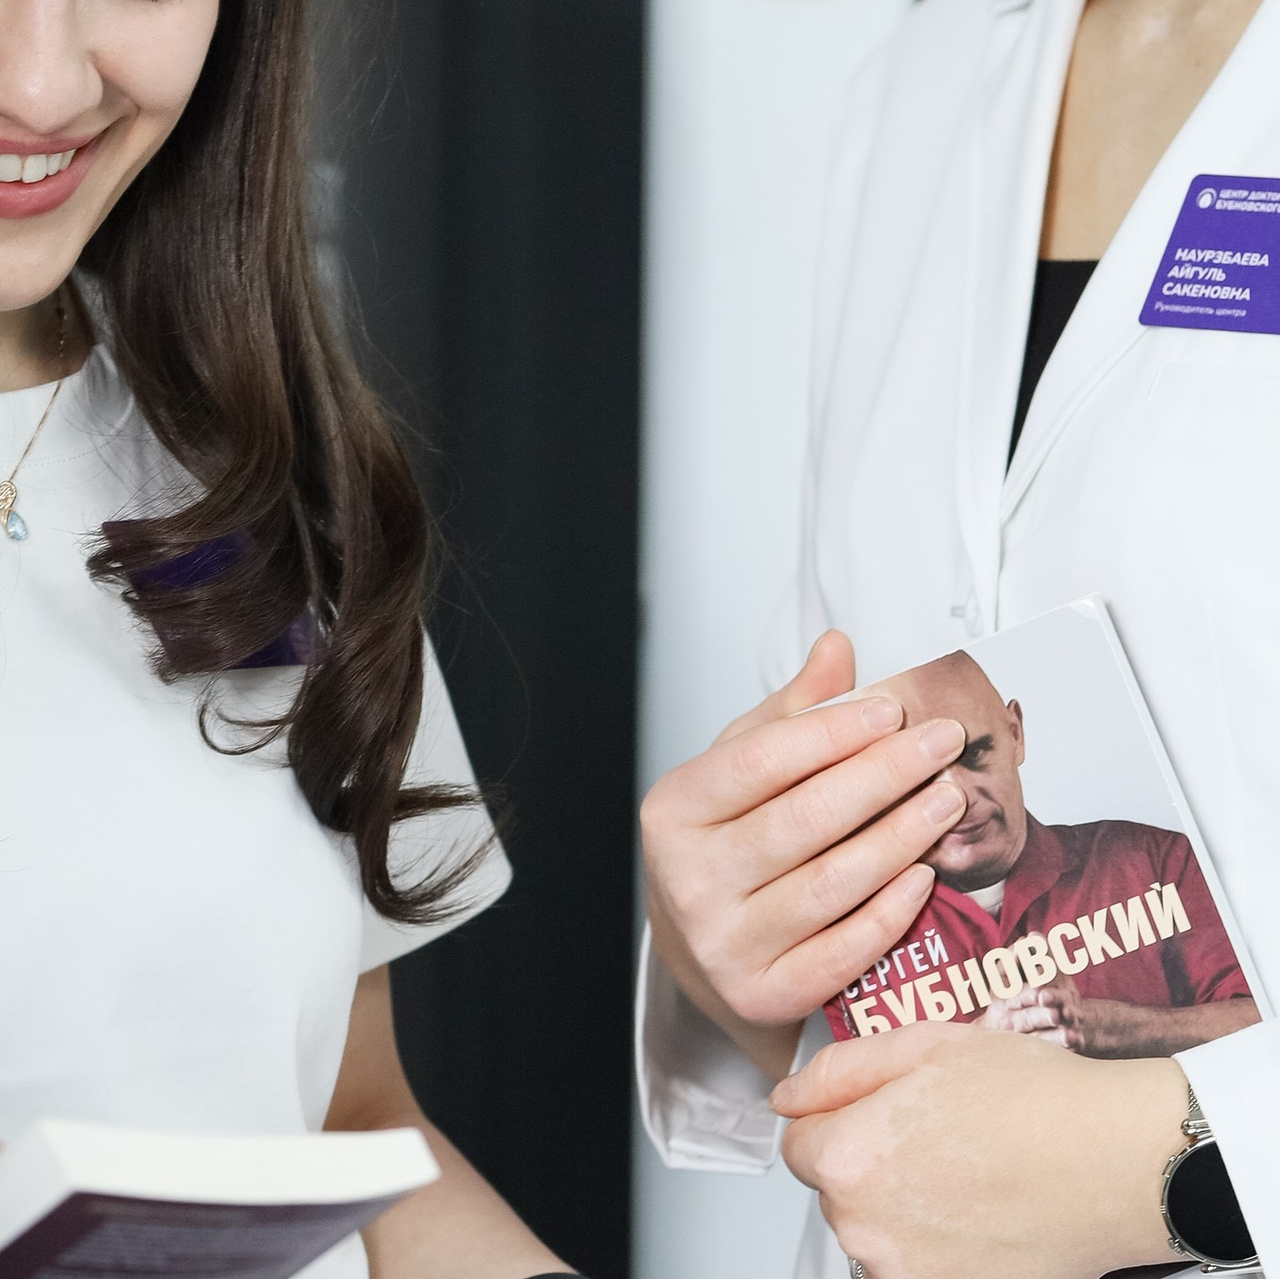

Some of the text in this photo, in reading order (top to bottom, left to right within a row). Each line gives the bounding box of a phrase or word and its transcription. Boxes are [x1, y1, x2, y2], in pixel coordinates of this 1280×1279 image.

[1219, 189, 1249, 199] ЦЕНТР
[1175, 248, 1269, 267] НАУРЗБАЕВА
[1167, 263, 1227, 282] АЙГУЛЬ
[1162, 282, 1251, 301] САКЕНОВНА
[1154, 301, 1247, 318] Руководитель центра
[849, 881, 1192, 1038] БУБНОВСКИЙ
